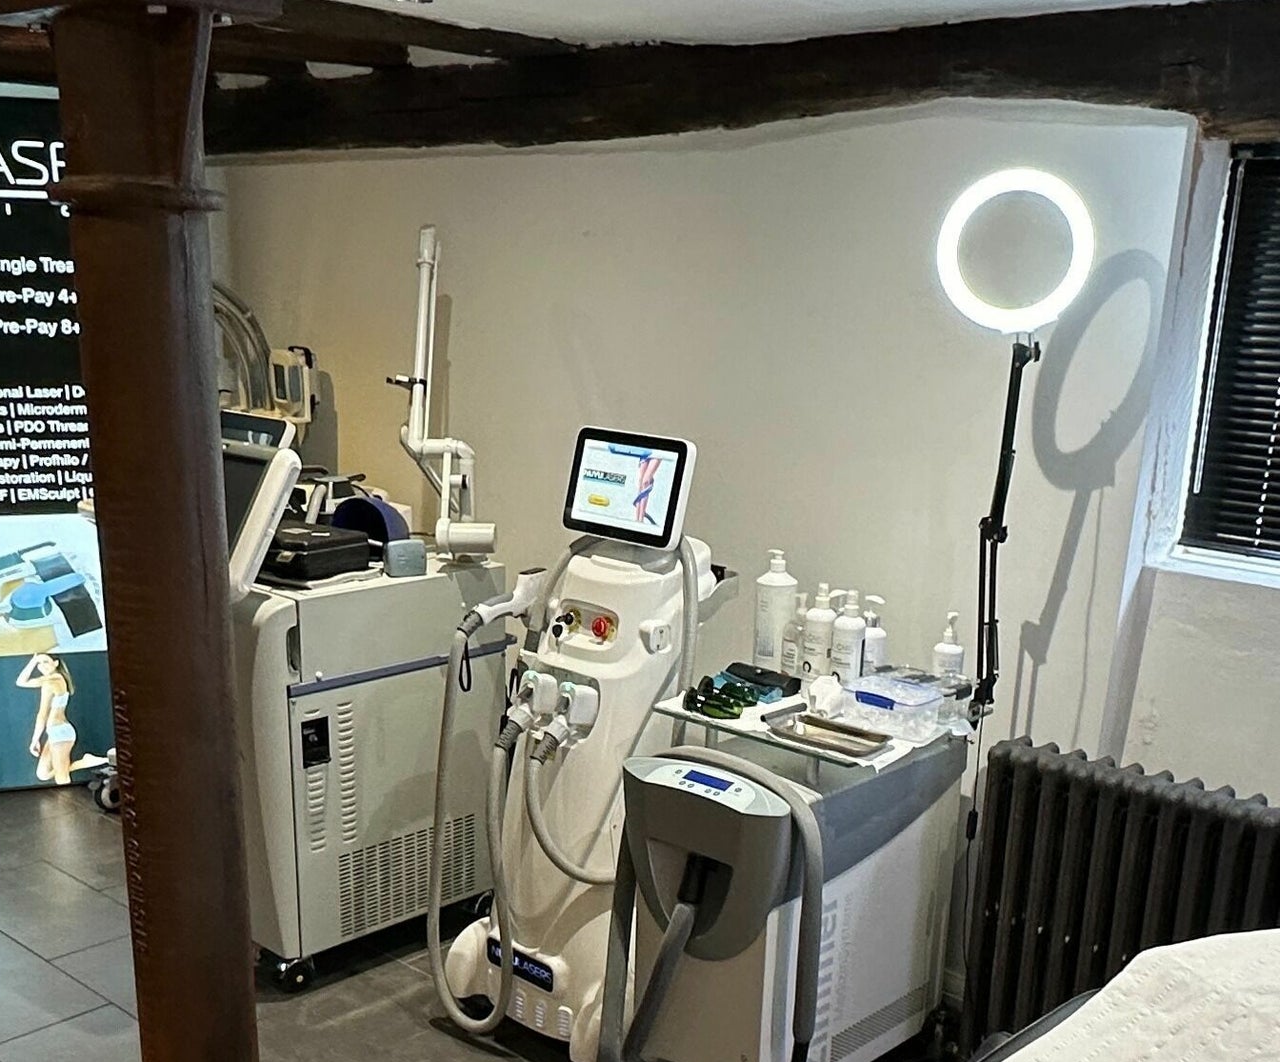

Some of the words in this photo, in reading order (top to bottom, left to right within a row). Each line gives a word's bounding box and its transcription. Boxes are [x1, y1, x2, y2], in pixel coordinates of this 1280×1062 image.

[39, 257, 74, 273] Trea
[26, 386, 63, 398] Laser
[72, 385, 85, 398] D
[17, 403, 87, 415] Microderm
[14, 420, 45, 433] PDO
[47, 420, 88, 432] Threa
[65, 471, 92, 485] Liqu
[18, 488, 81, 501] EMSculpt
